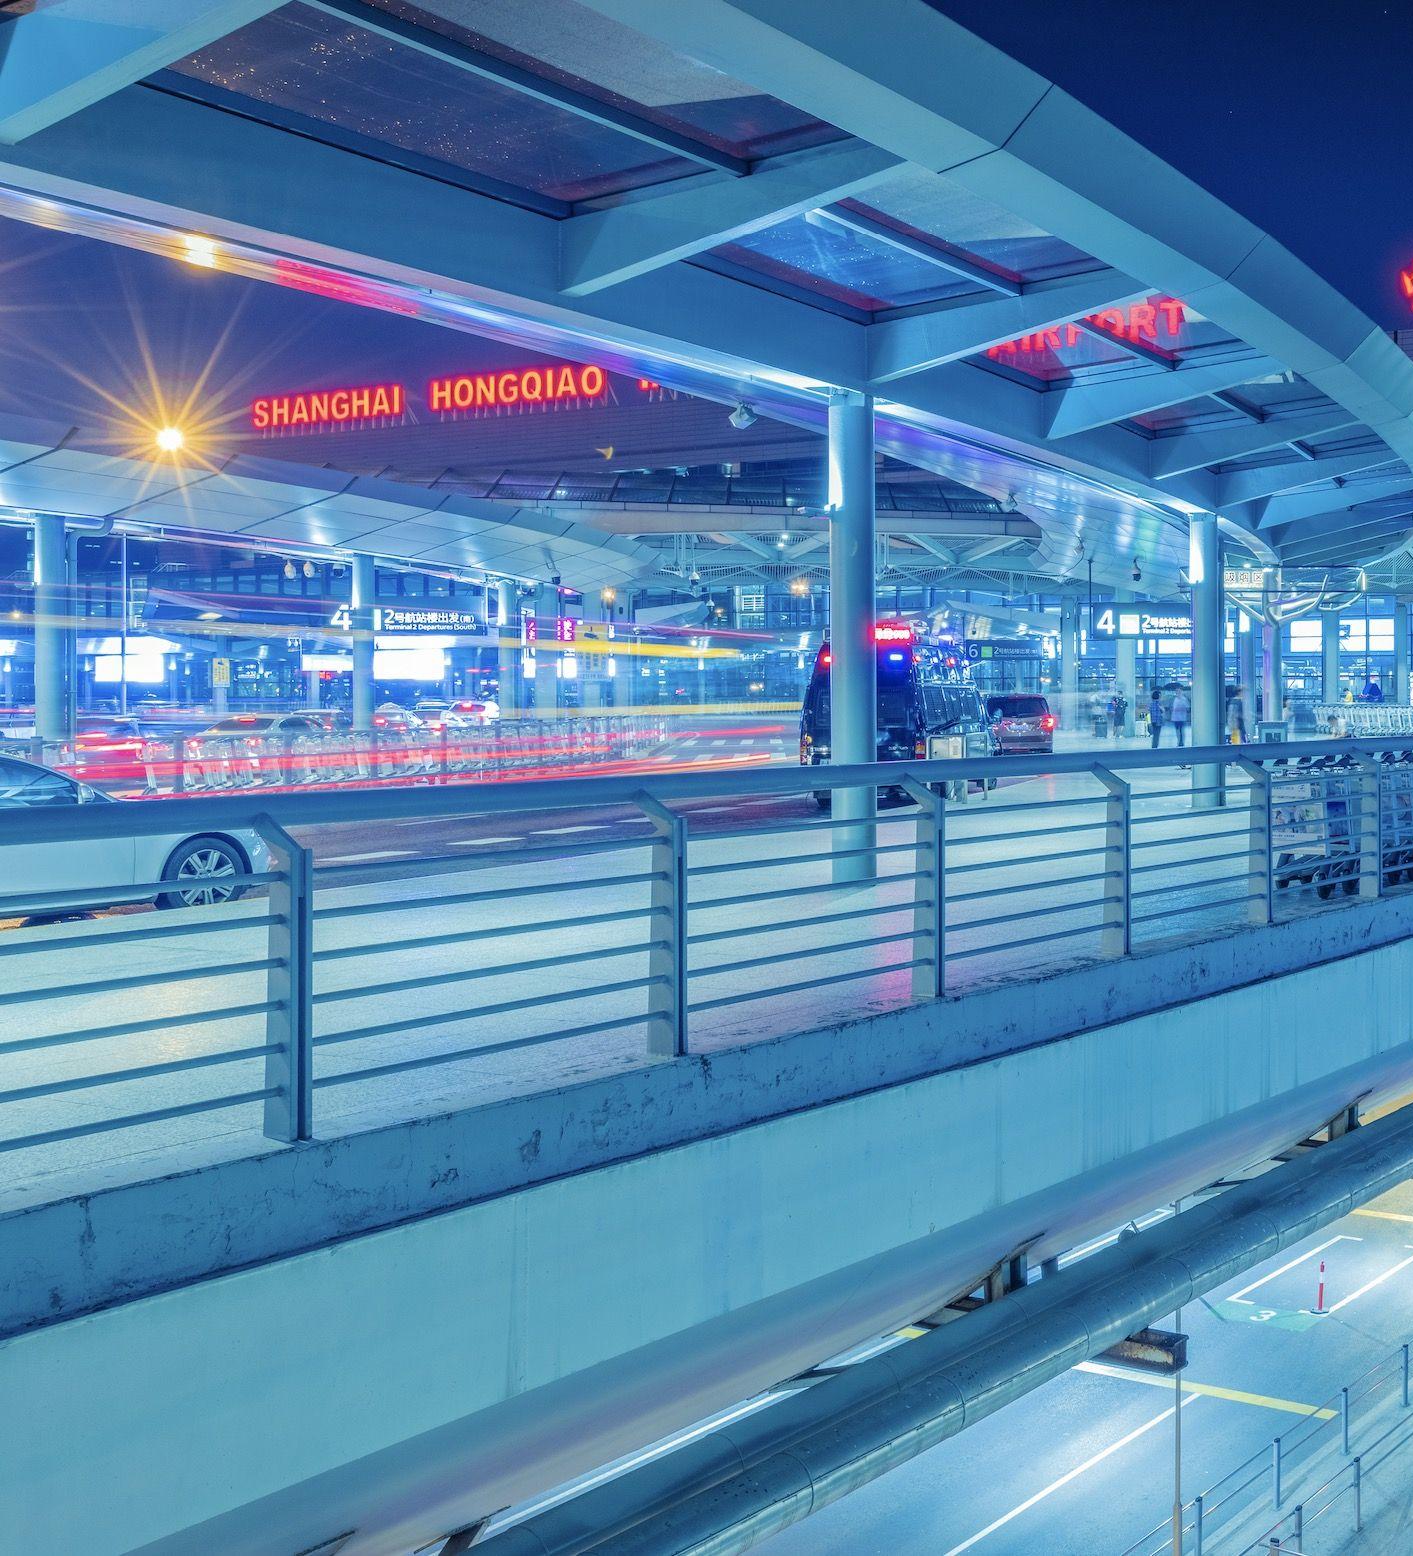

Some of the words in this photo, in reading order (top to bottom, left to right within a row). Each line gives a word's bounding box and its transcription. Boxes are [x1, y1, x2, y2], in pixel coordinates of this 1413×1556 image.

[253, 385, 401, 428] SHANGHAI
[431, 364, 606, 411] HONGQIAO
[330, 604, 353, 631] 4
[1096, 609, 1116, 635] 4
[418, 624, 453, 632] Departures
[968, 643, 978, 658] 6
[1249, 1309, 1277, 1321] 3
